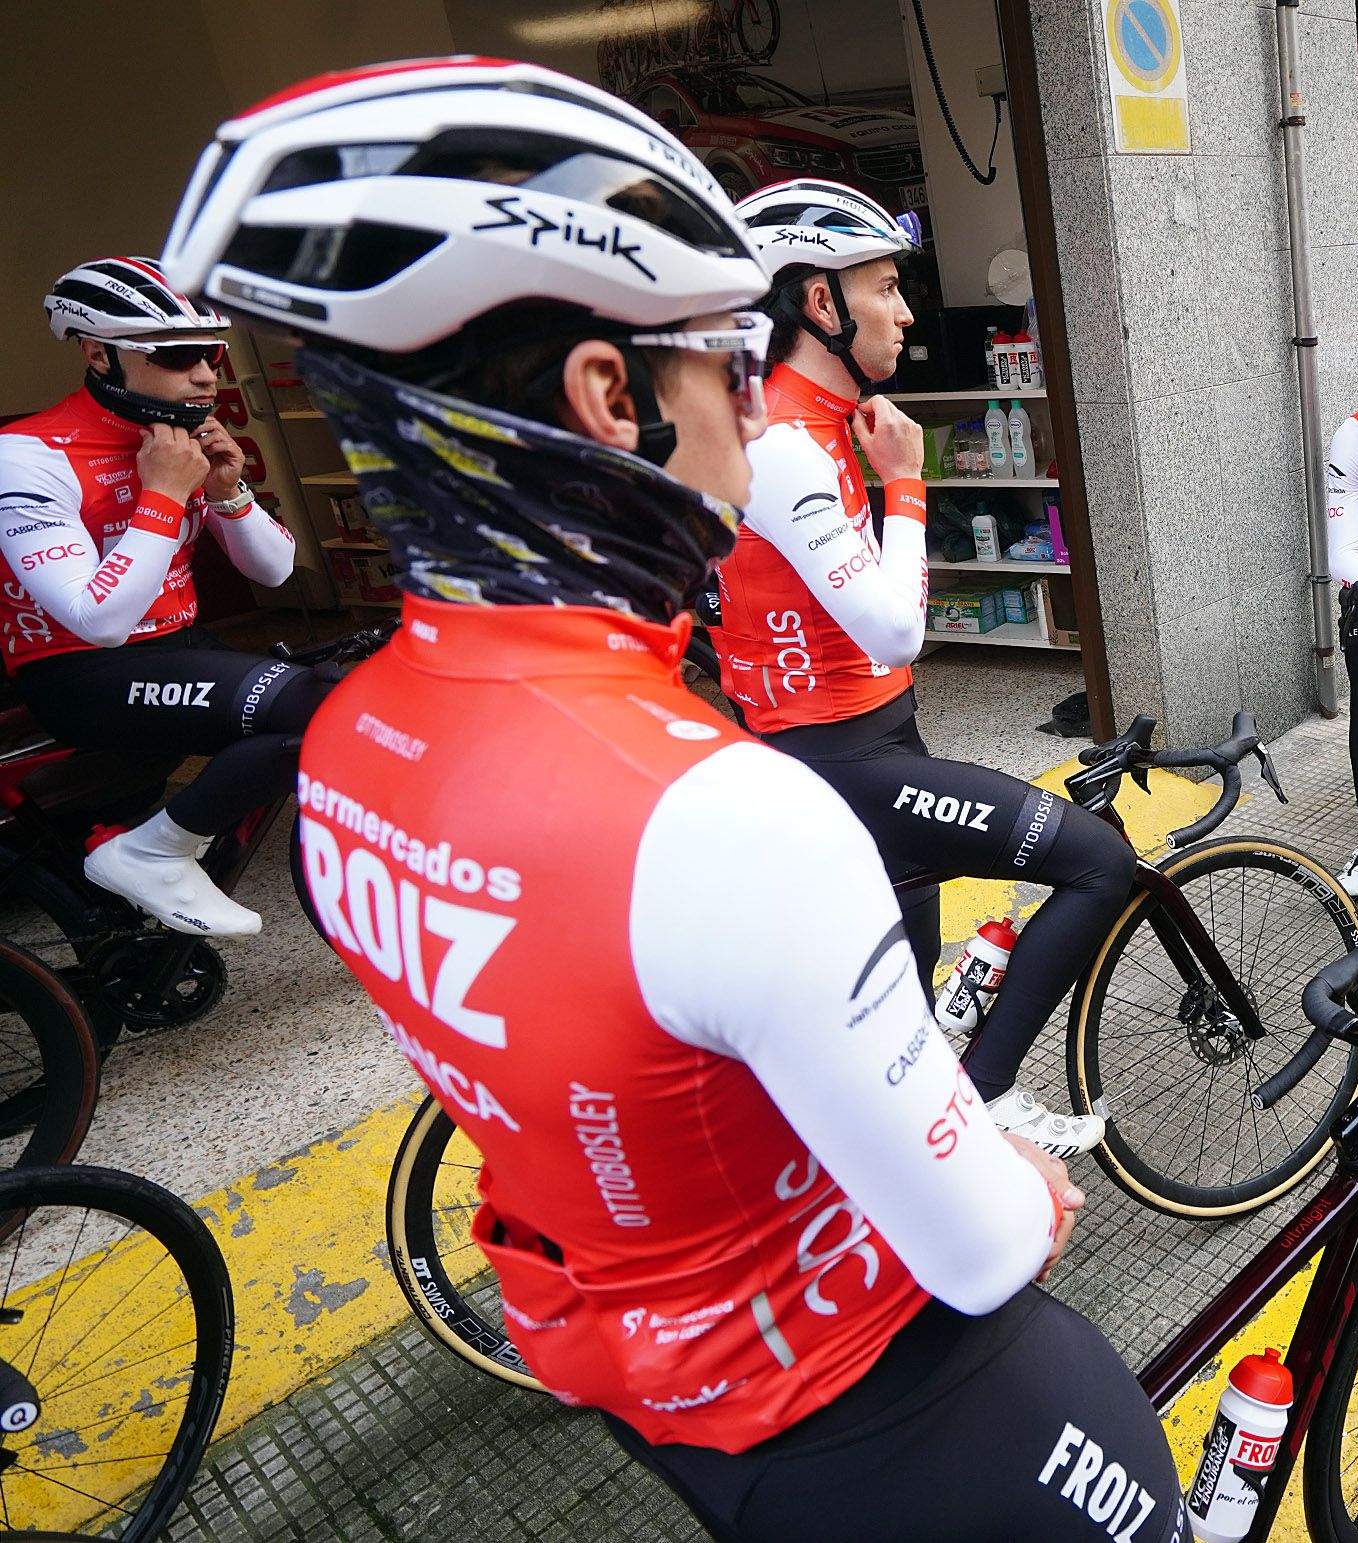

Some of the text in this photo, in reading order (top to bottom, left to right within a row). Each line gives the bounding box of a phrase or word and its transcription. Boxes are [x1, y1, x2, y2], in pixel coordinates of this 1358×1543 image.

[473, 196, 657, 282] Spiuk
[772, 228, 837, 253] Spiuk
[53, 299, 96, 325] Spiuk
[86, 552, 133, 605] FROIZ
[127, 681, 216, 708] FROIZ
[893, 784, 996, 832] FROIZ
[569, 1081, 650, 1227] OTTOBOSLEY
[411, 1257, 455, 1319] DT SWISS
[217, 1328, 232, 1396] PIRELLI
[1038, 1421, 1156, 1543] FROIZ
[1190, 1438, 1220, 1511] VICTORY
[1204, 1433, 1229, 1506] ENDURANCE
[1216, 1493, 1235, 1504] por
